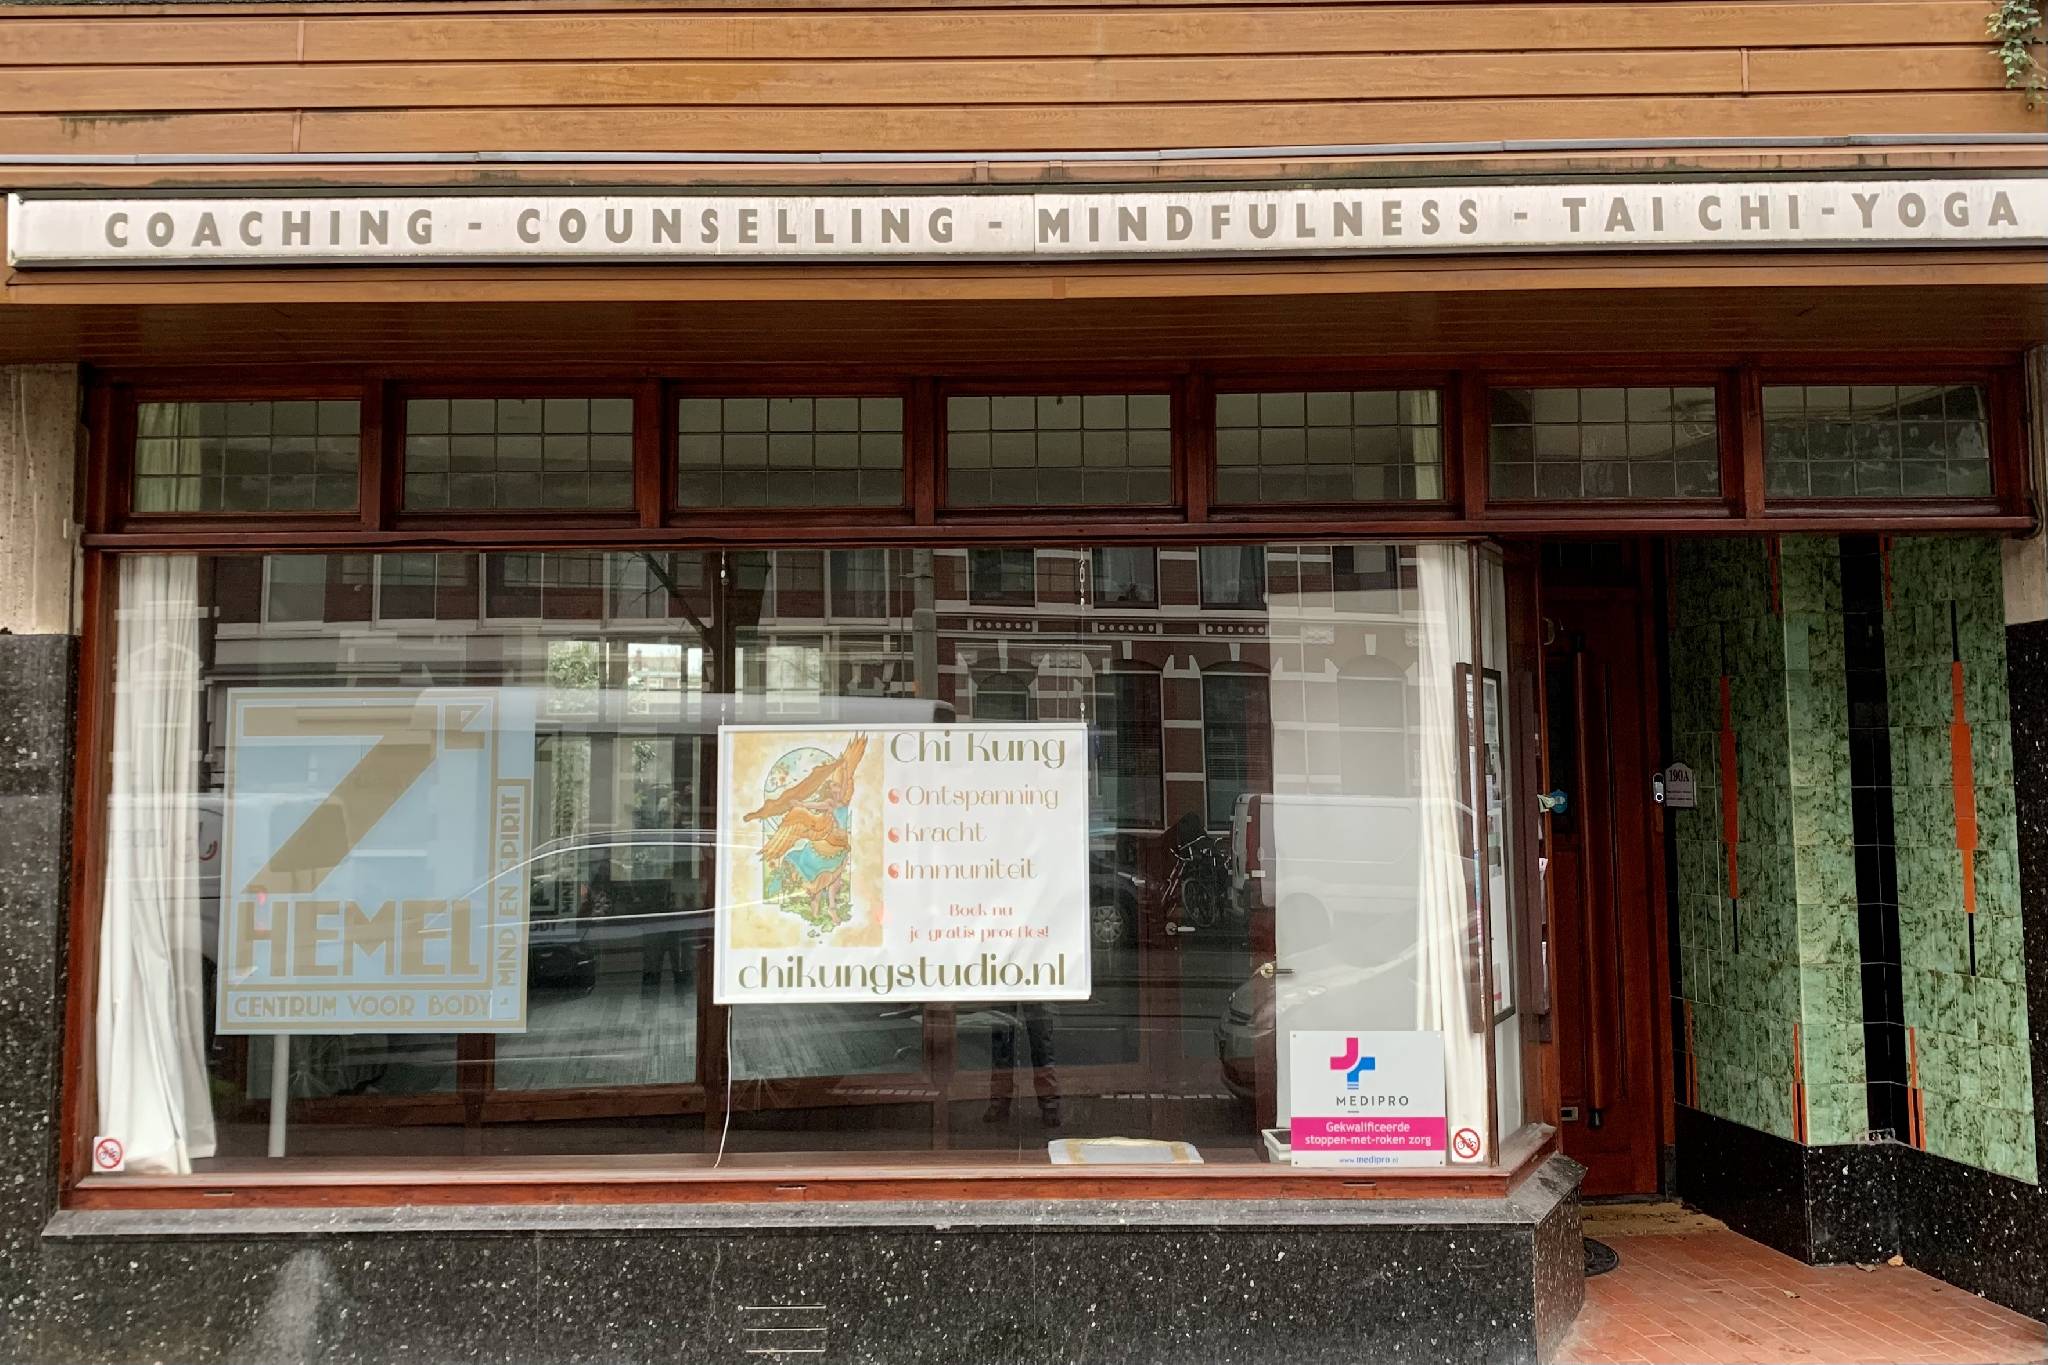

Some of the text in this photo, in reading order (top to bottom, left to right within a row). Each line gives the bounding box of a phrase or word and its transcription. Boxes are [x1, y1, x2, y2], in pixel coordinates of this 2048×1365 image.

[105, 209, 433, 248] COACHING
[516, 207, 953, 244] COUNSELLING
[1038, 199, 1478, 244] MINDFULNESS
[1561, 197, 1664, 234] TAI
[890, 729, 1067, 769] Chi Kung
[905, 784, 1059, 811] Ontspanning
[904, 822, 988, 843] Kracht
[904, 858, 1038, 881] Immuniteit
[499, 886, 518, 917] EN
[235, 900, 481, 978] HEMEL
[497, 928, 517, 987] MIND
[738, 953, 1066, 995] chikungstudio.nl
[234, 996, 337, 1018] CENTRUM
[348, 996, 416, 1017] VOOR
[1336, 1095, 1409, 1106] MEDIPRO
[1325, 1121, 1410, 1133] Gekwalificeerde
[1304, 1135, 1432, 1147] stoppen-met-roken zorg
